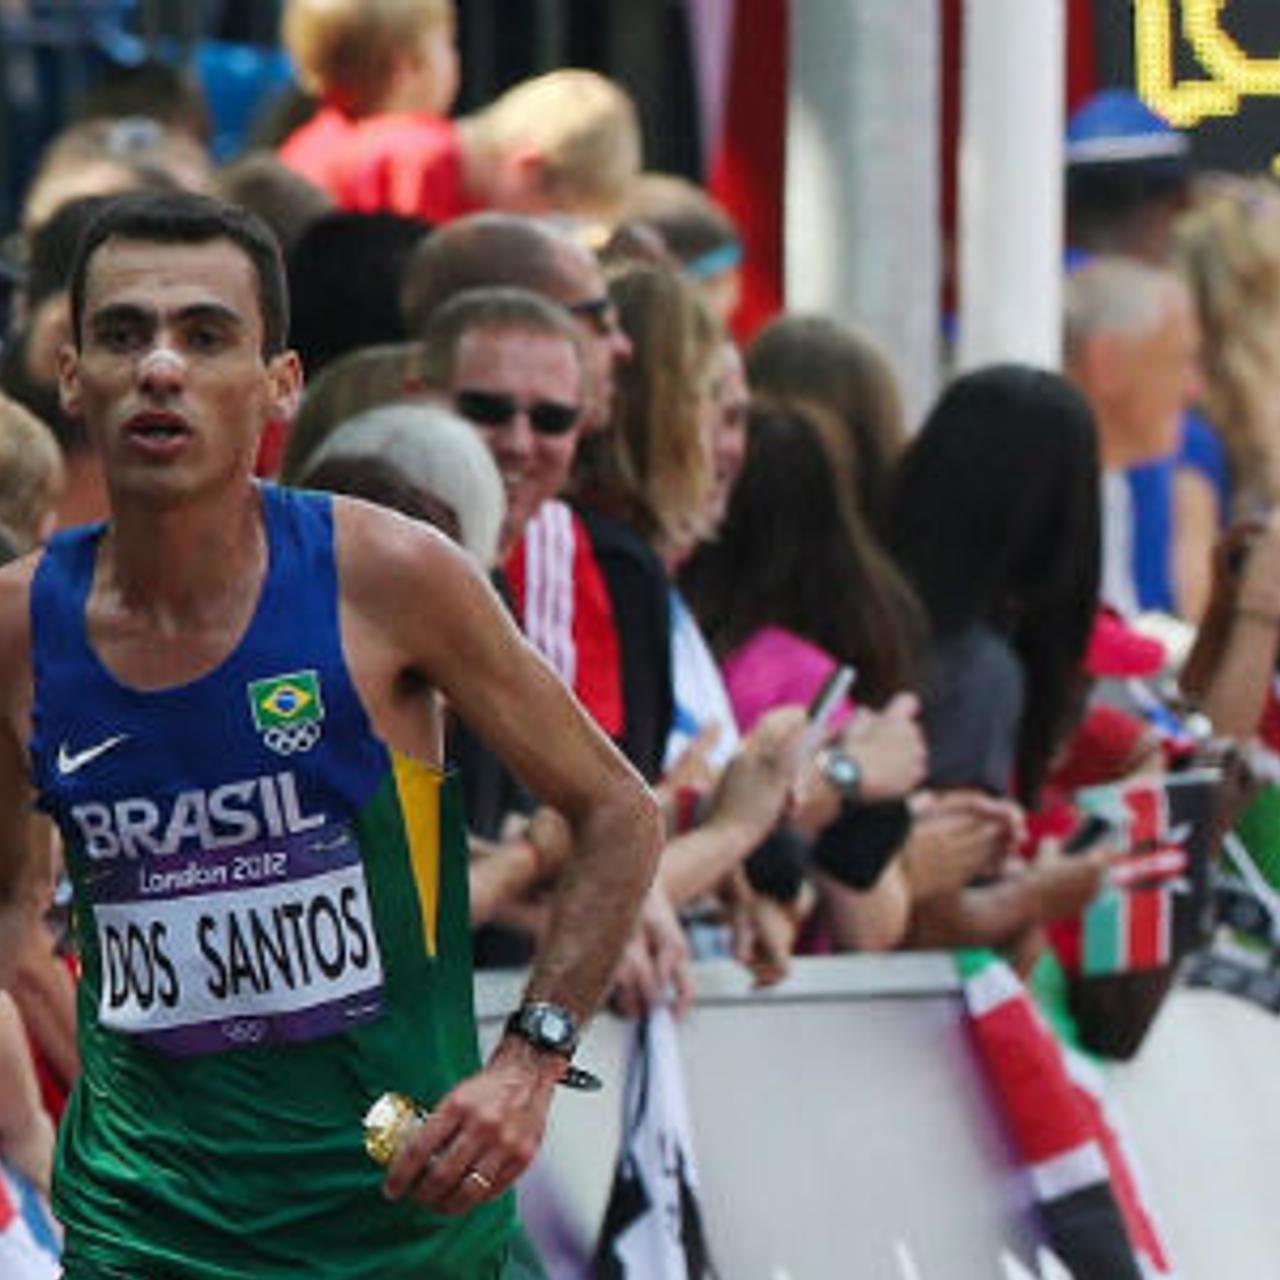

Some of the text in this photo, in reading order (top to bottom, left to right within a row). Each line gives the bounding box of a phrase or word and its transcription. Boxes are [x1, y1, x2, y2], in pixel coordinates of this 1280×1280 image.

[72, 771, 326, 861] BRASIL
[140, 852, 288, 893] London 2012
[105, 886, 368, 1009] DOS SANTOS
